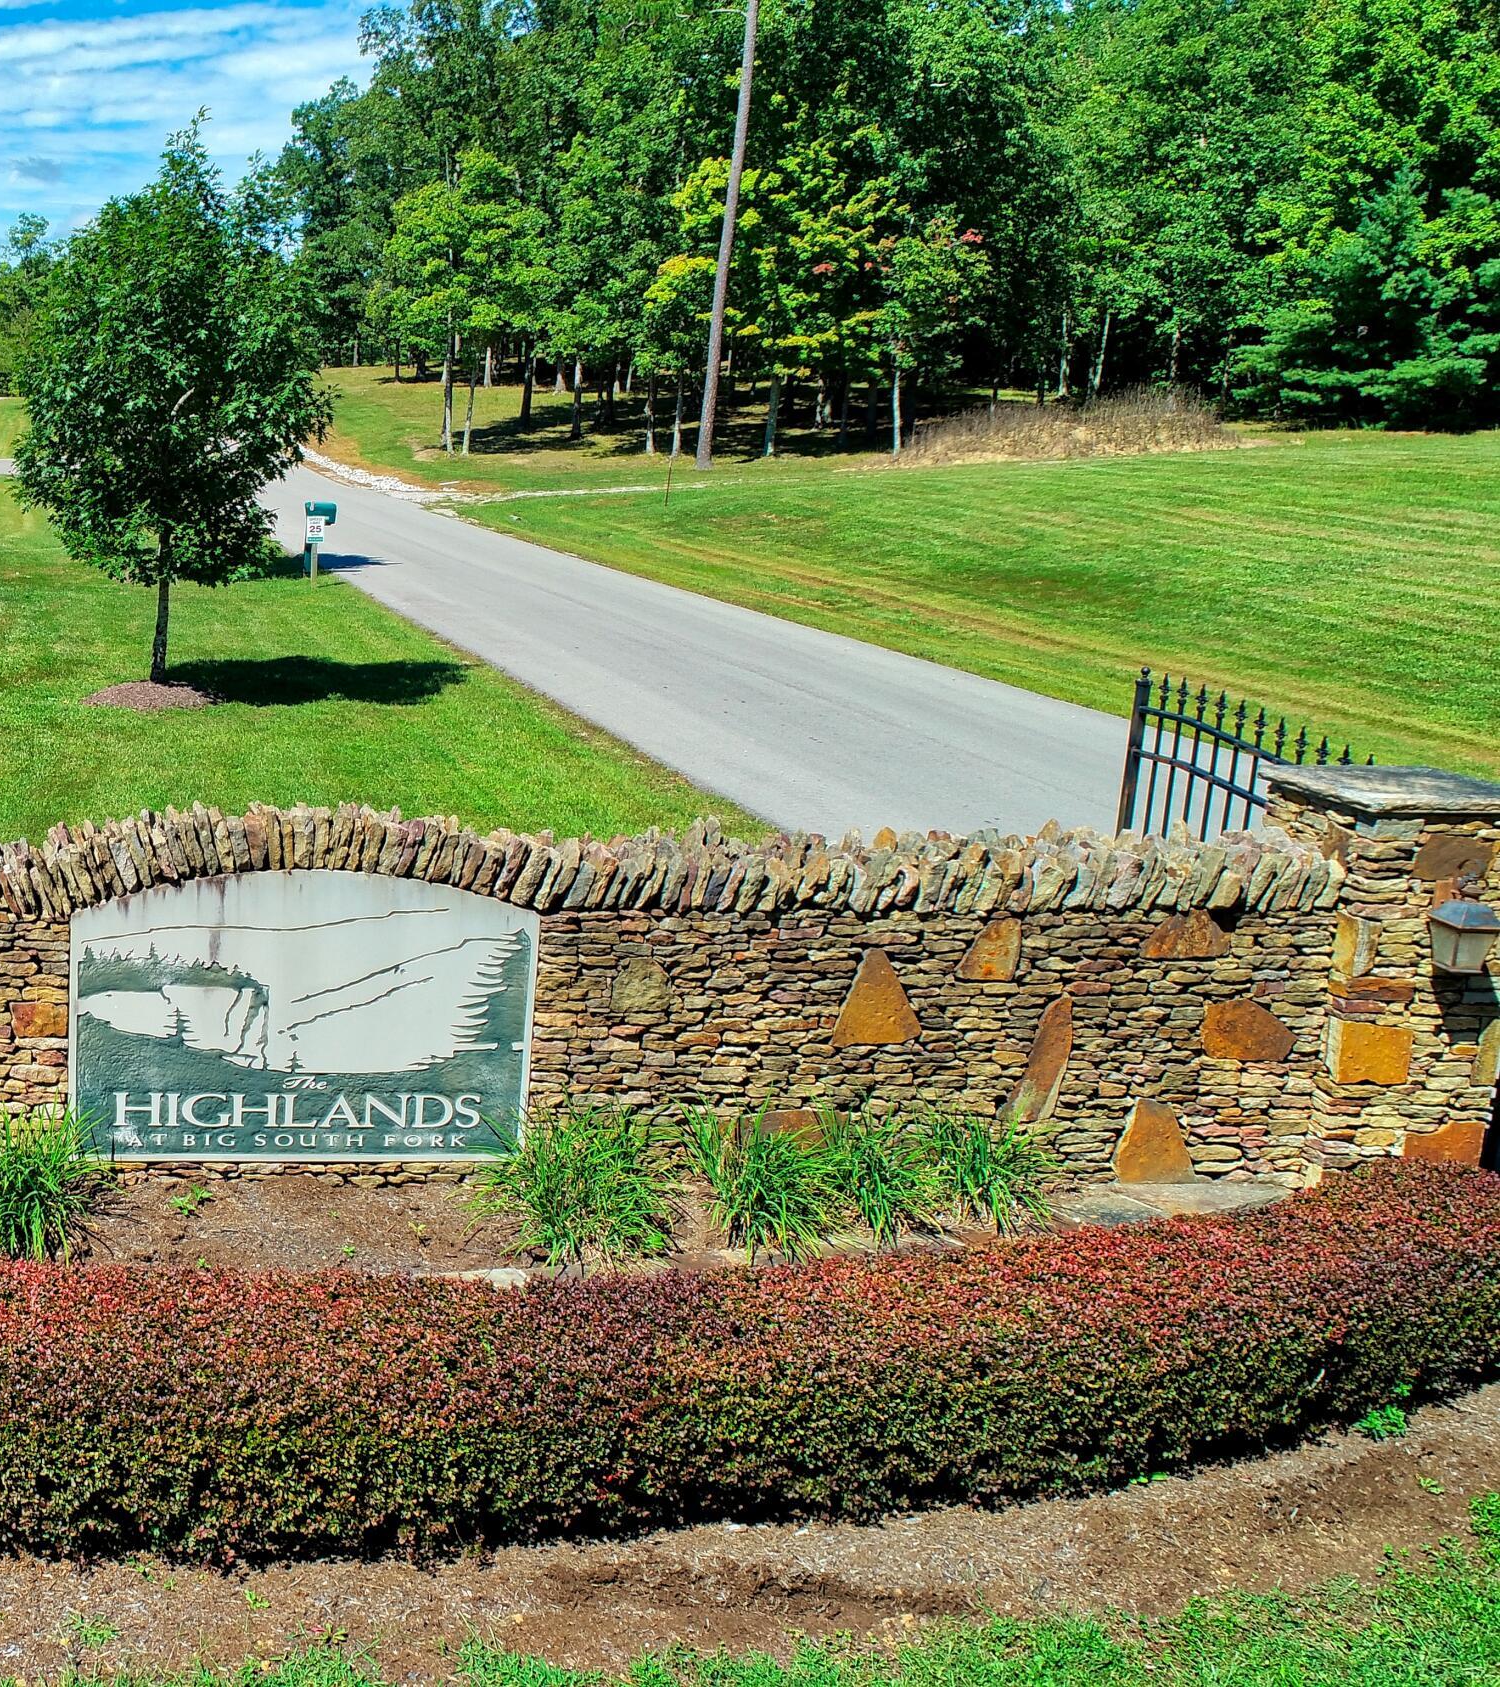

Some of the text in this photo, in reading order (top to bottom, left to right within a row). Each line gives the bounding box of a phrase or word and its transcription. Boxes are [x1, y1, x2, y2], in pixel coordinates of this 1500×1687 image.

[309, 525, 322, 533] 25
[282, 1076, 328, 1090] The
[113, 1093, 482, 1128] HIGHLANDS
[127, 1133, 466, 1147] AT BIG SOUTH FORK
